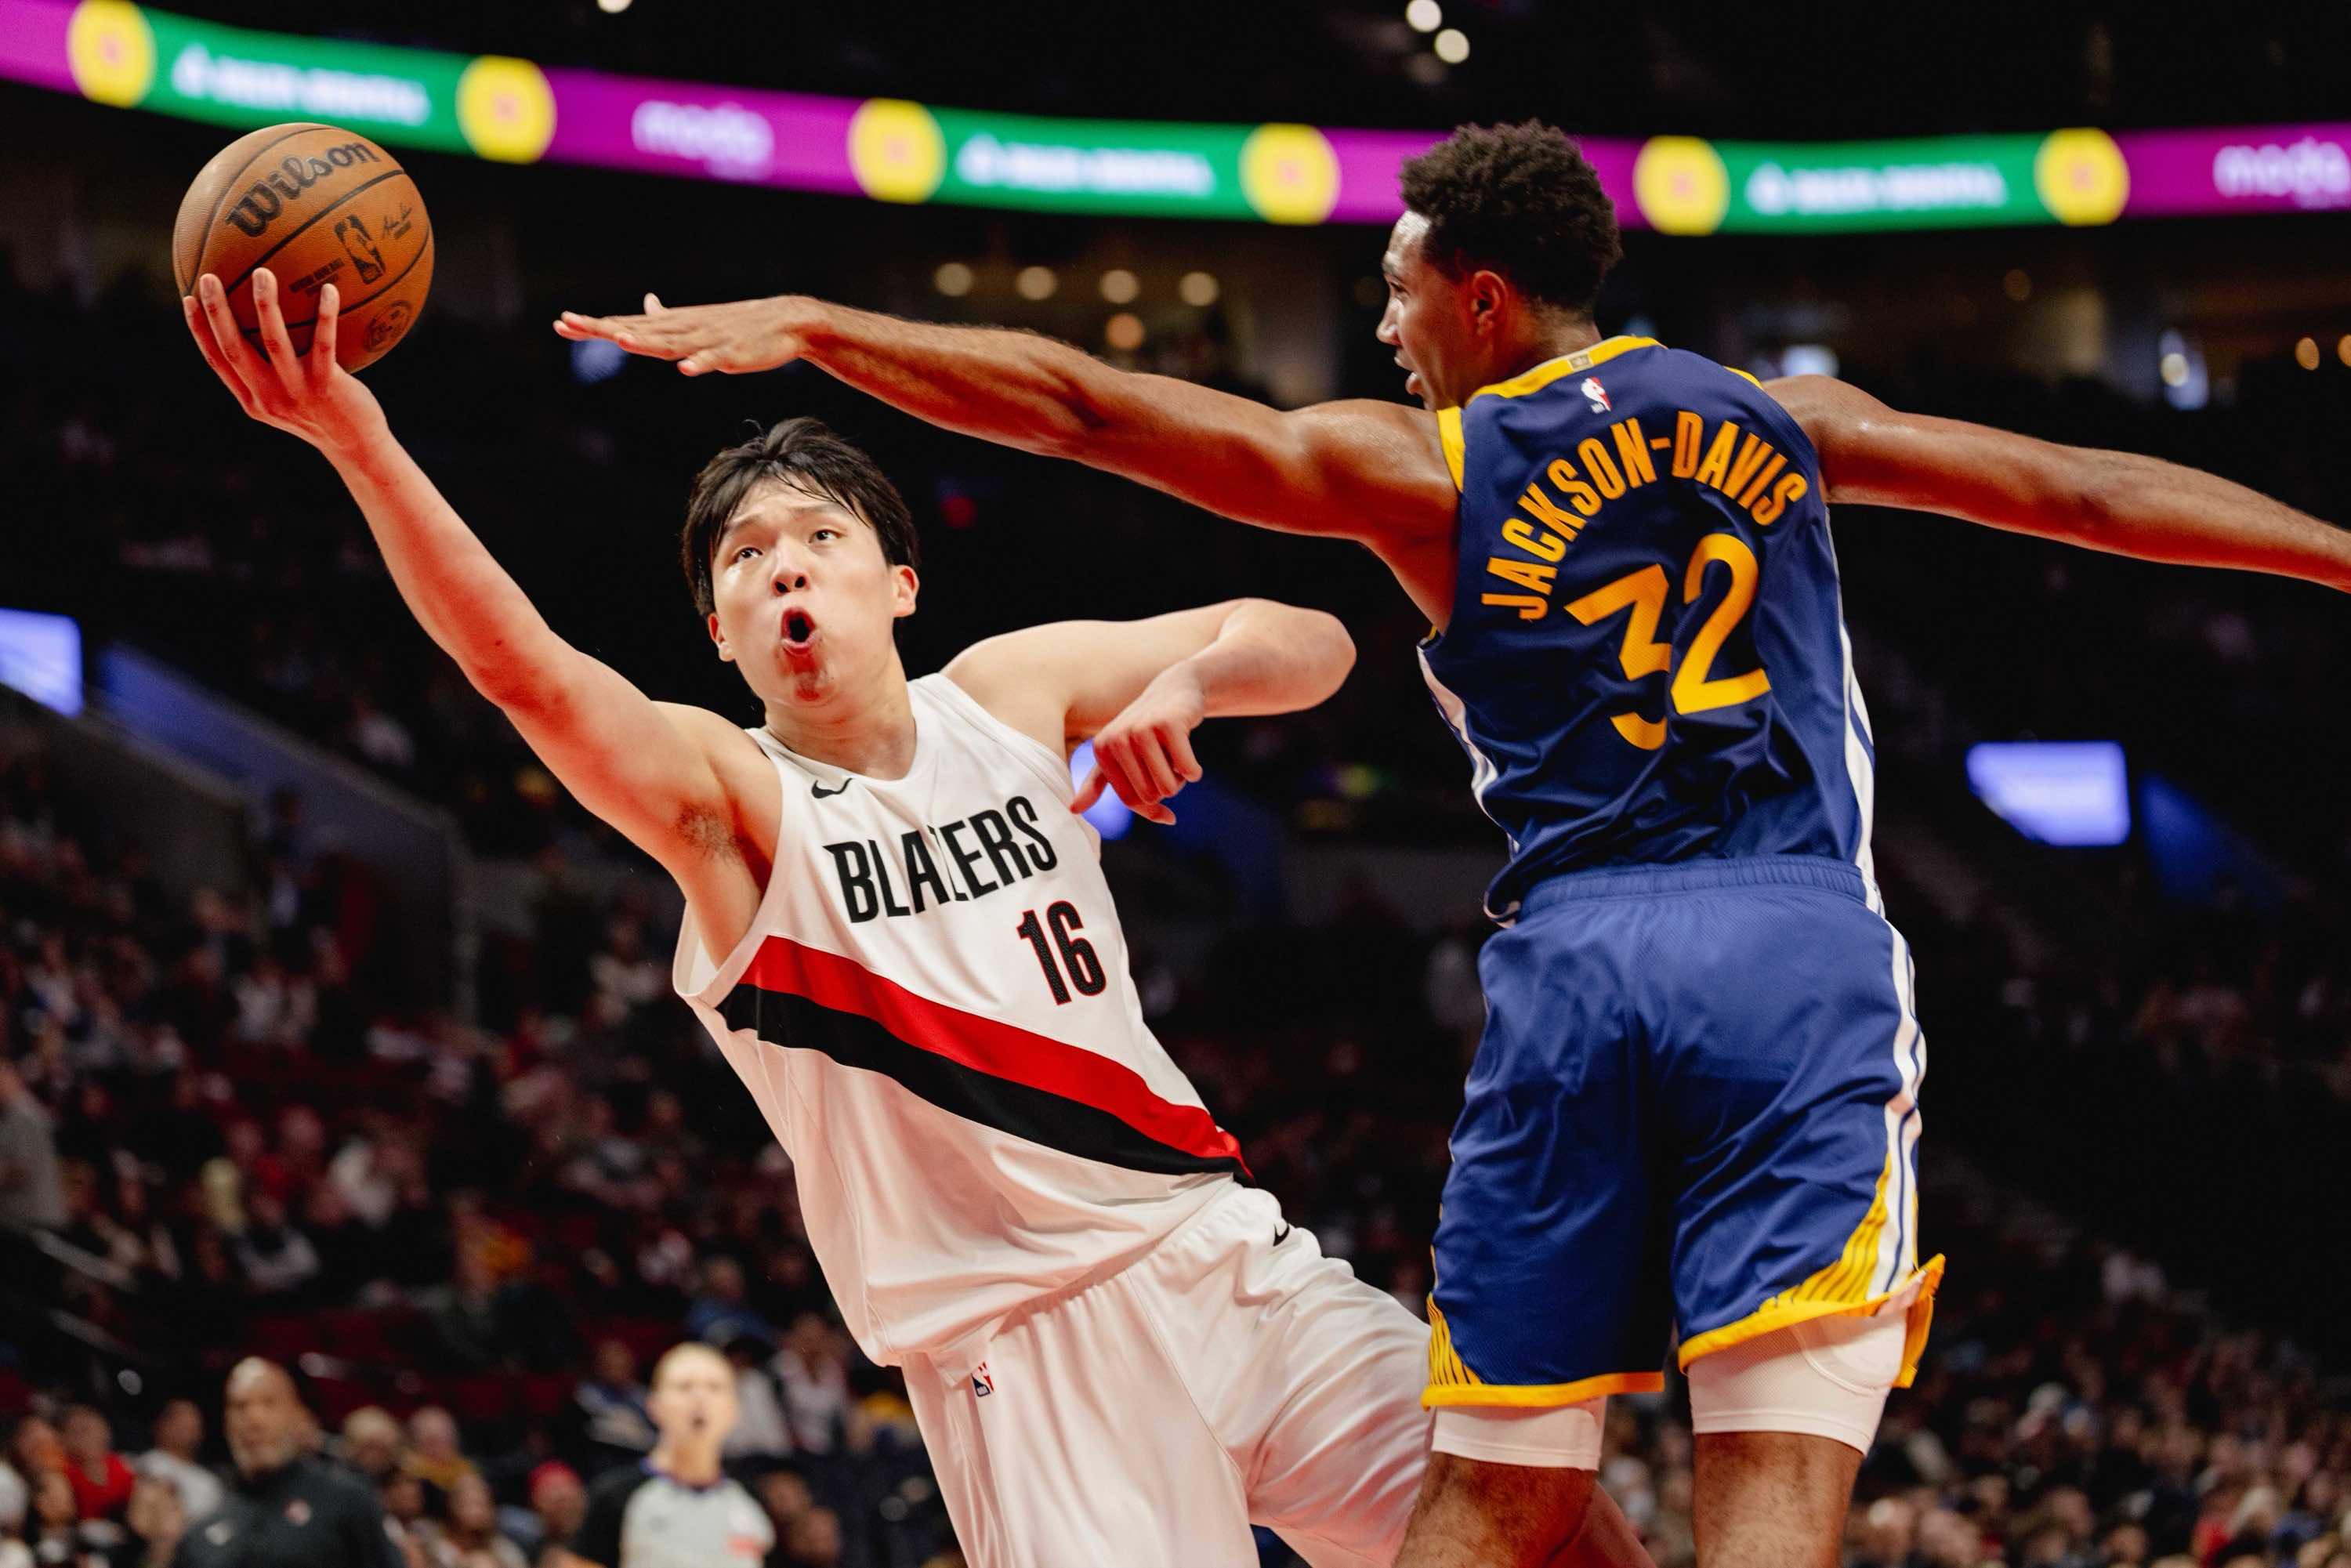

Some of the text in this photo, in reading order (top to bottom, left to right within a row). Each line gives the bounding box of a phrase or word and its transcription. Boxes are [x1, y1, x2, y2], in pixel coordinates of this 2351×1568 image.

[226, 142, 380, 237] Wilson
[1481, 411, 1807, 621] JACKSON-DAVIS
[1563, 533, 1771, 751] 32
[823, 795, 1058, 923] BLAERS
[1016, 900, 1107, 1005] 16
